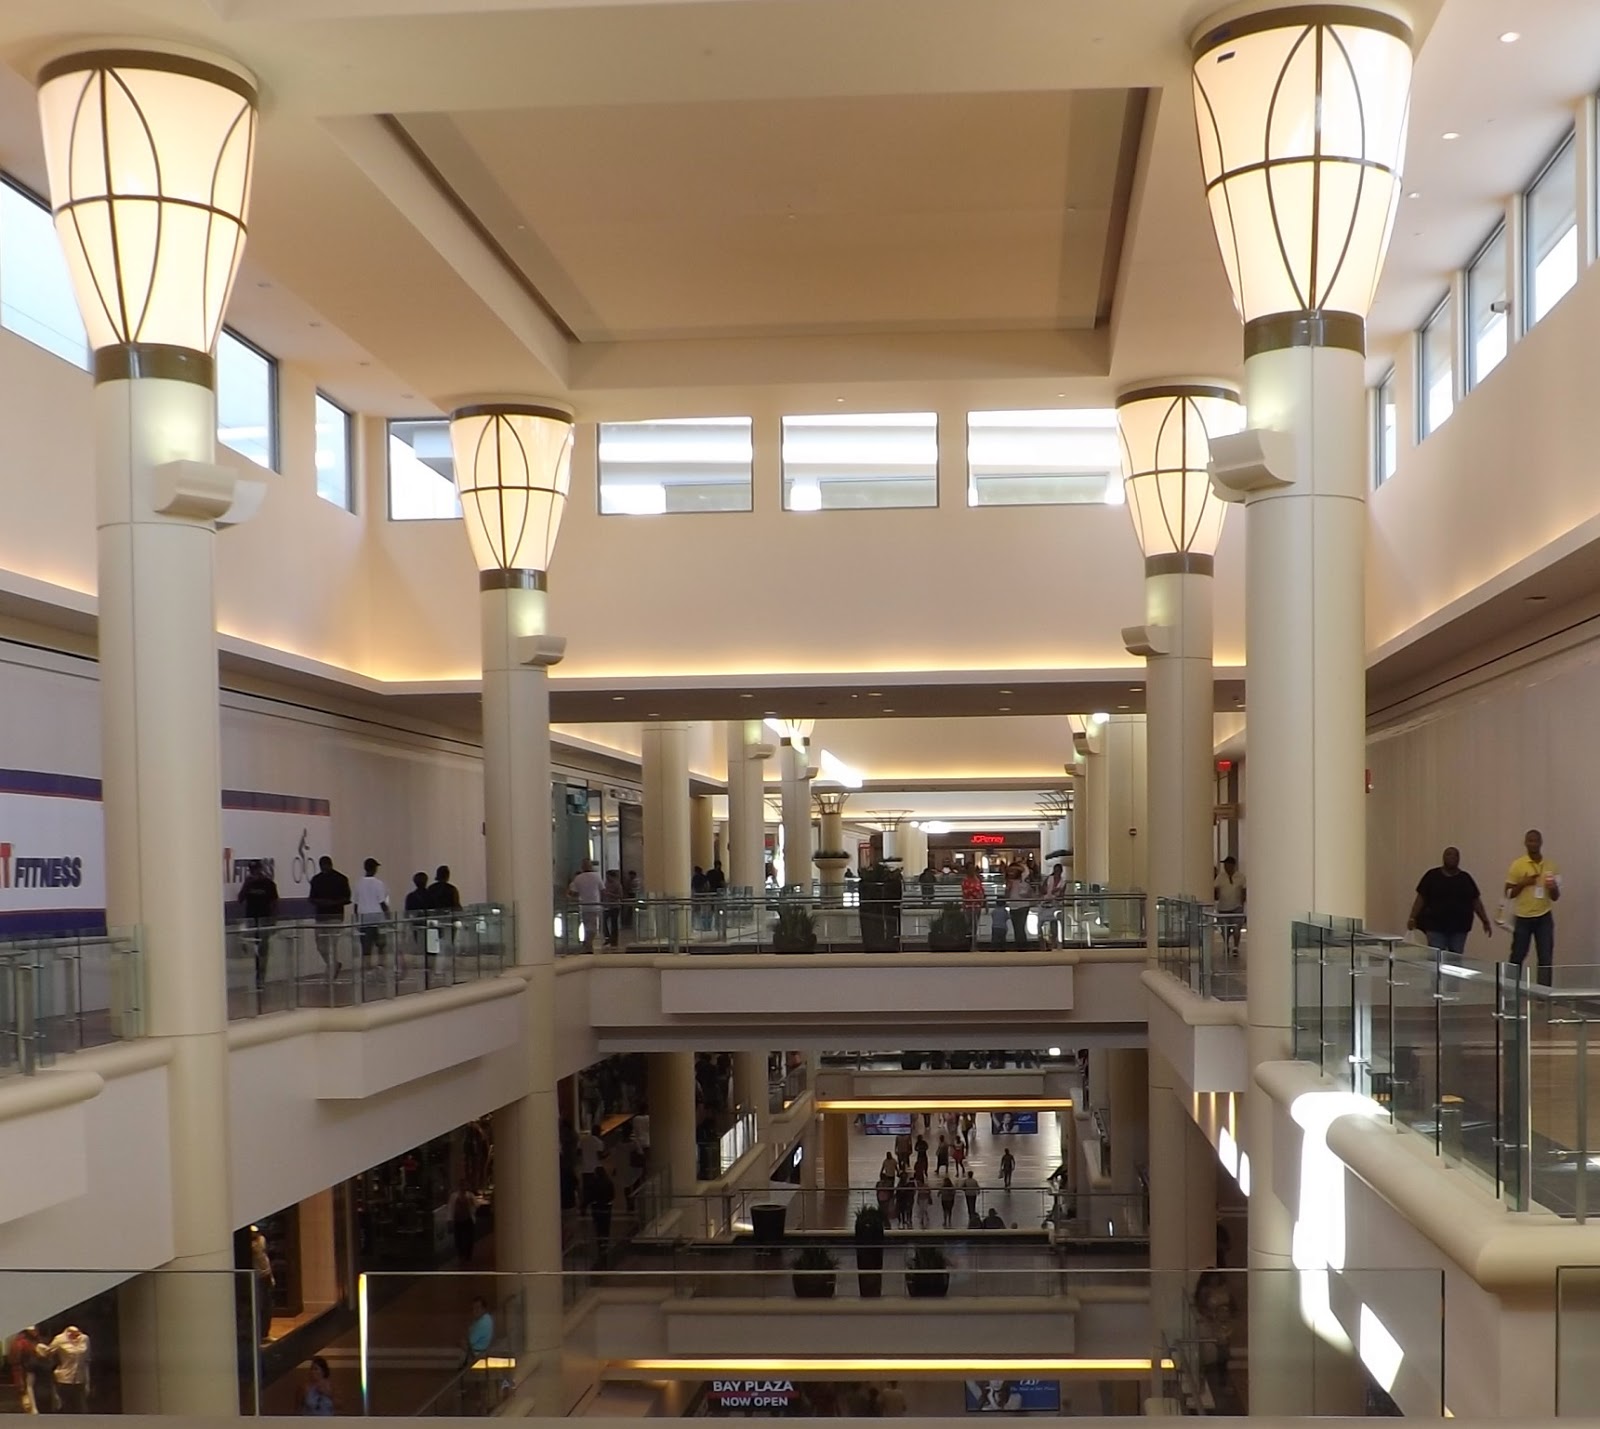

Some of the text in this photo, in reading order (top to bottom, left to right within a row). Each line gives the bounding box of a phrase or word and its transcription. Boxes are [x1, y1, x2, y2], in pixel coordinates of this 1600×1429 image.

[14, 856, 82, 888] FITNESS
[713, 1380, 794, 1392] BAY PLAZA
[720, 1396, 789, 1407] NOW OPEN
